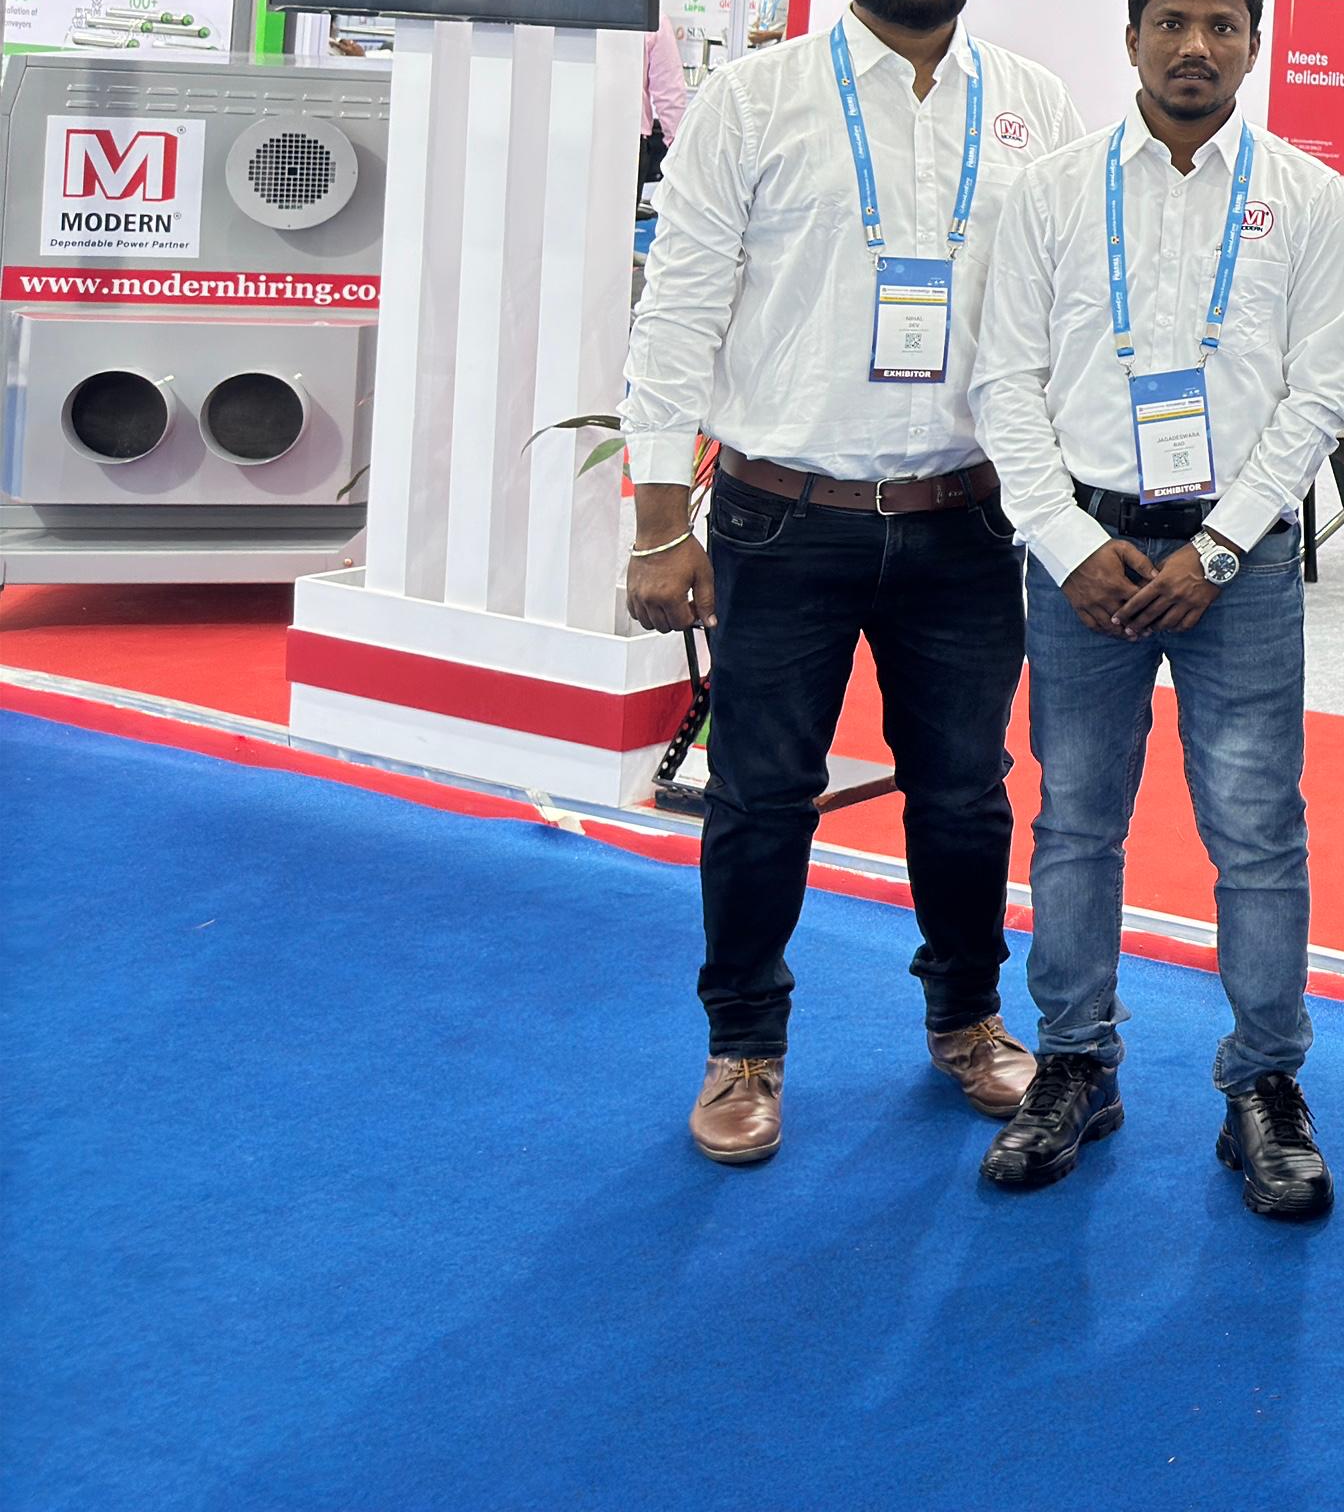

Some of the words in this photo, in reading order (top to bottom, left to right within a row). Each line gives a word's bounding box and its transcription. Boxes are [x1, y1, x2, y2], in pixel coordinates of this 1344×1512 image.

[1288, 51, 1328, 66] Meets
[63, 129, 178, 202] M
[60, 211, 172, 234] MODERN
[50, 239, 113, 249] Dependable
[116, 240, 149, 249] Power
[152, 240, 190, 250] Partner
[883, 369, 931, 378] EXHIBITOR
[1154, 483, 1202, 497] EXHIBITOR
